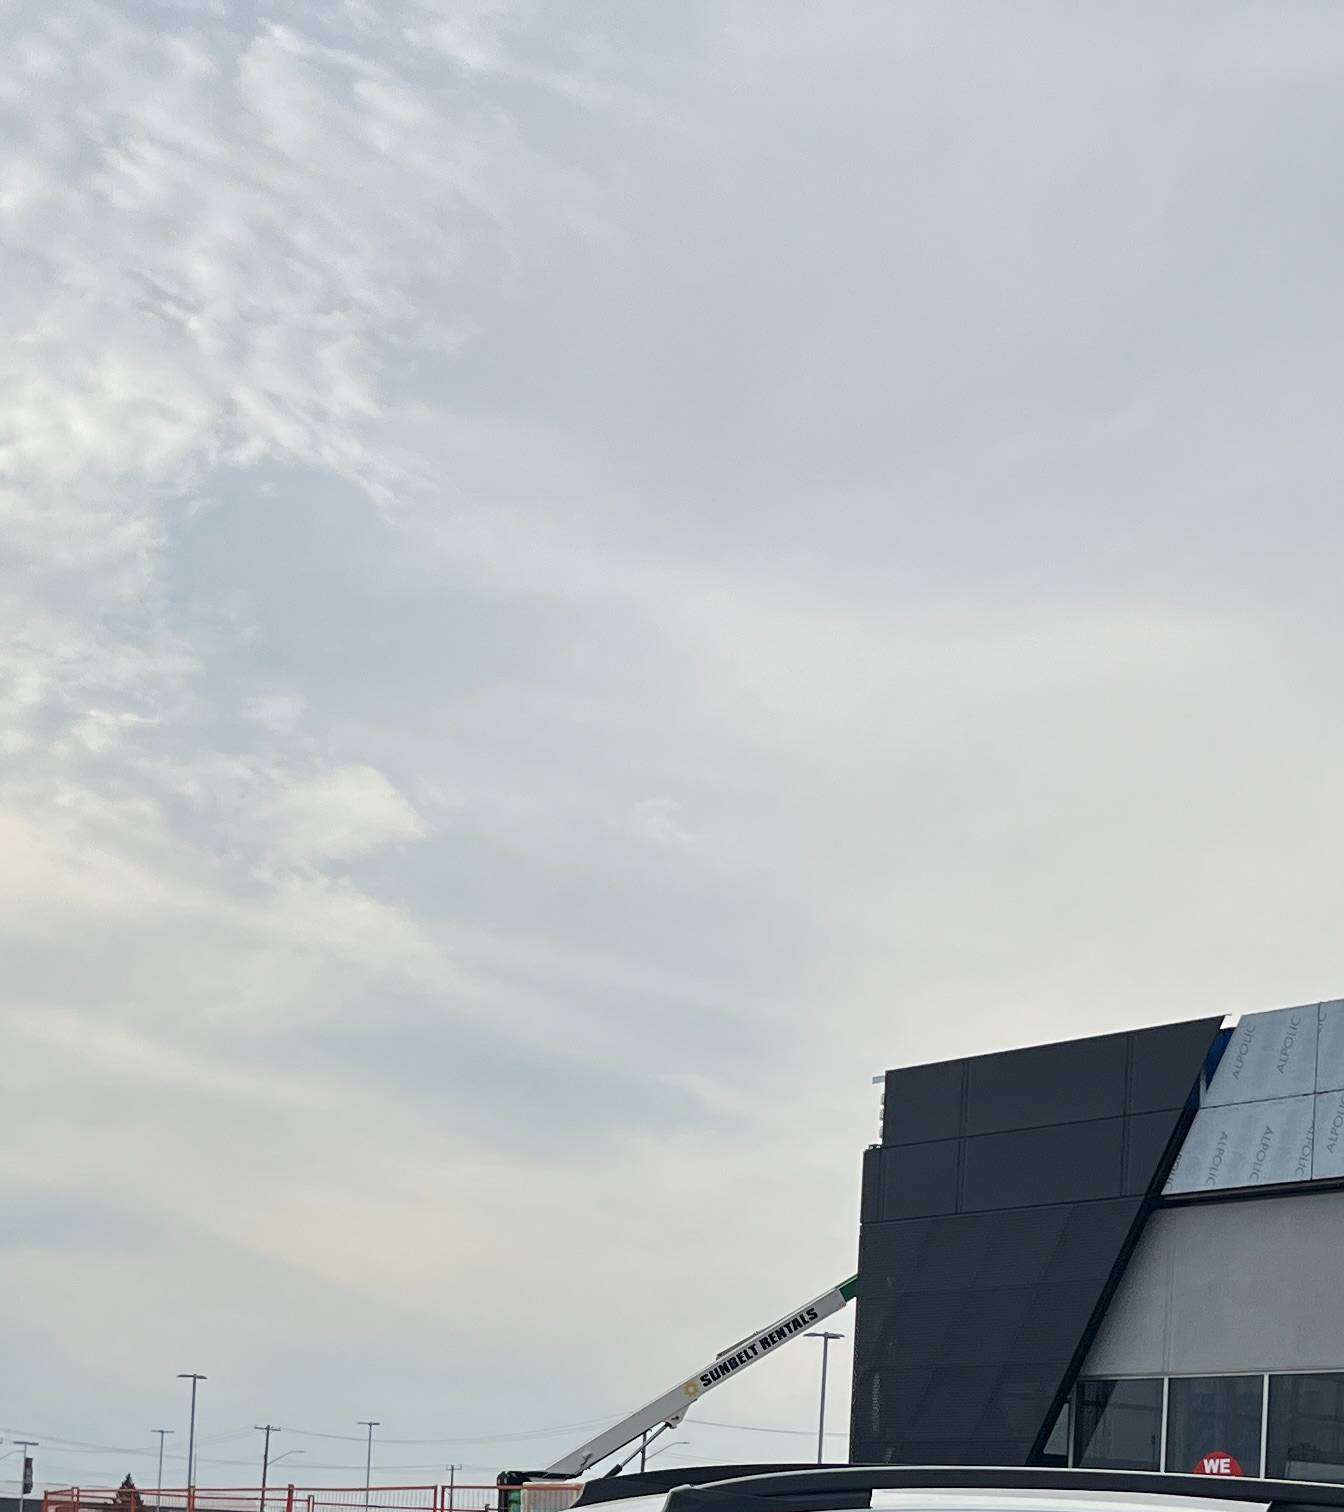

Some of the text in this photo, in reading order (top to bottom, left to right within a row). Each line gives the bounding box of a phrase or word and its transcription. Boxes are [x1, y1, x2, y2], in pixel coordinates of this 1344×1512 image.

[1231, 1026, 1256, 1080] ALPOLIC
[1276, 1016, 1302, 1074] ALPOLIC
[700, 1307, 818, 1387] SUNBELT RENTALS
[1203, 1458, 1230, 1474] WE
